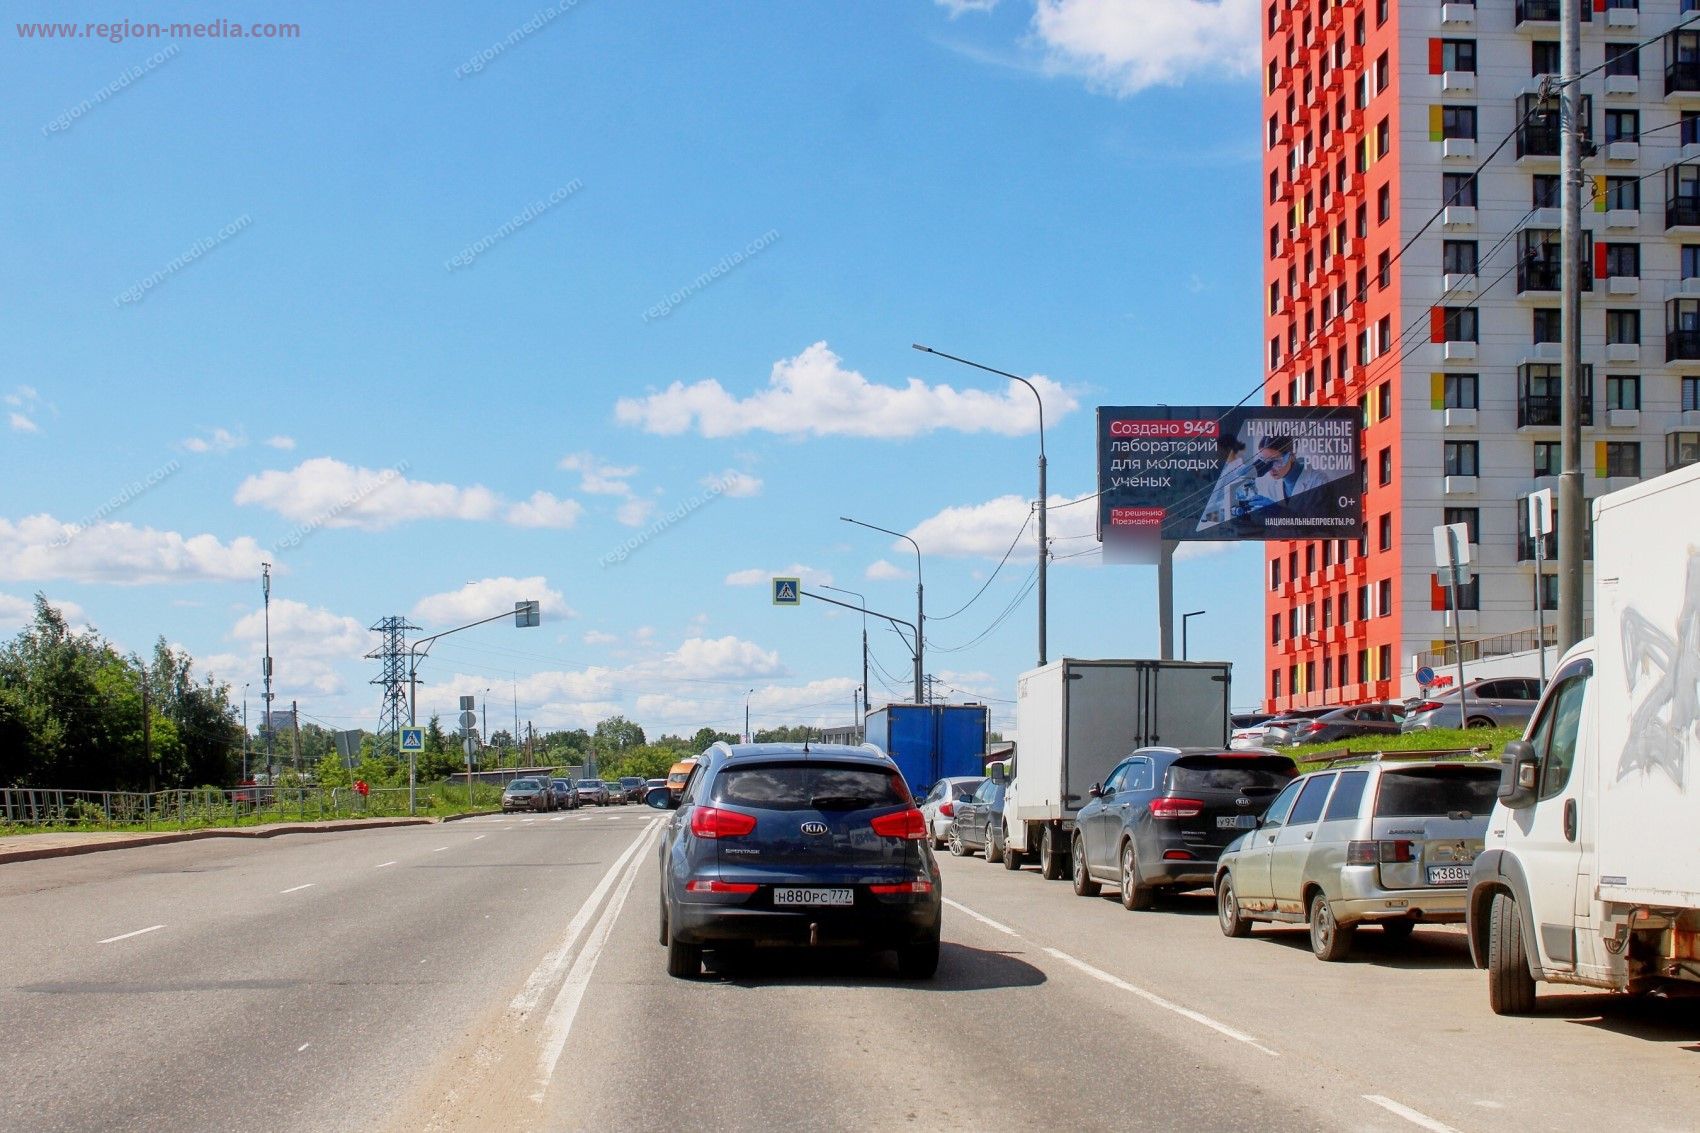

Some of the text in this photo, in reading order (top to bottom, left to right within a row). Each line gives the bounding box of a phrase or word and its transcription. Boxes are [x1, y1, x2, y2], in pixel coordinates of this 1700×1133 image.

[1111, 421, 1216, 436] Создано 940
[1247, 421, 1352, 438] НАЦИОНАЛЬНЫЕ
[1110, 438, 1218, 454] лабораторий
[1292, 438, 1352, 453] ПРОЕКТЫ
[1110, 459, 1219, 471] для молодых
[1304, 455, 1353, 470] РОССИИ
[1338, 496, 1356, 508] 0+
[1112, 509, 1123, 517] По
[1265, 517, 1356, 526] НАЦИОНАЛЬНЫЕПРОЕКТЫ.РФ
[803, 823, 826, 834] KIA
[1432, 867, 1471, 880] М388Н
[830, 889, 850, 900] 777
